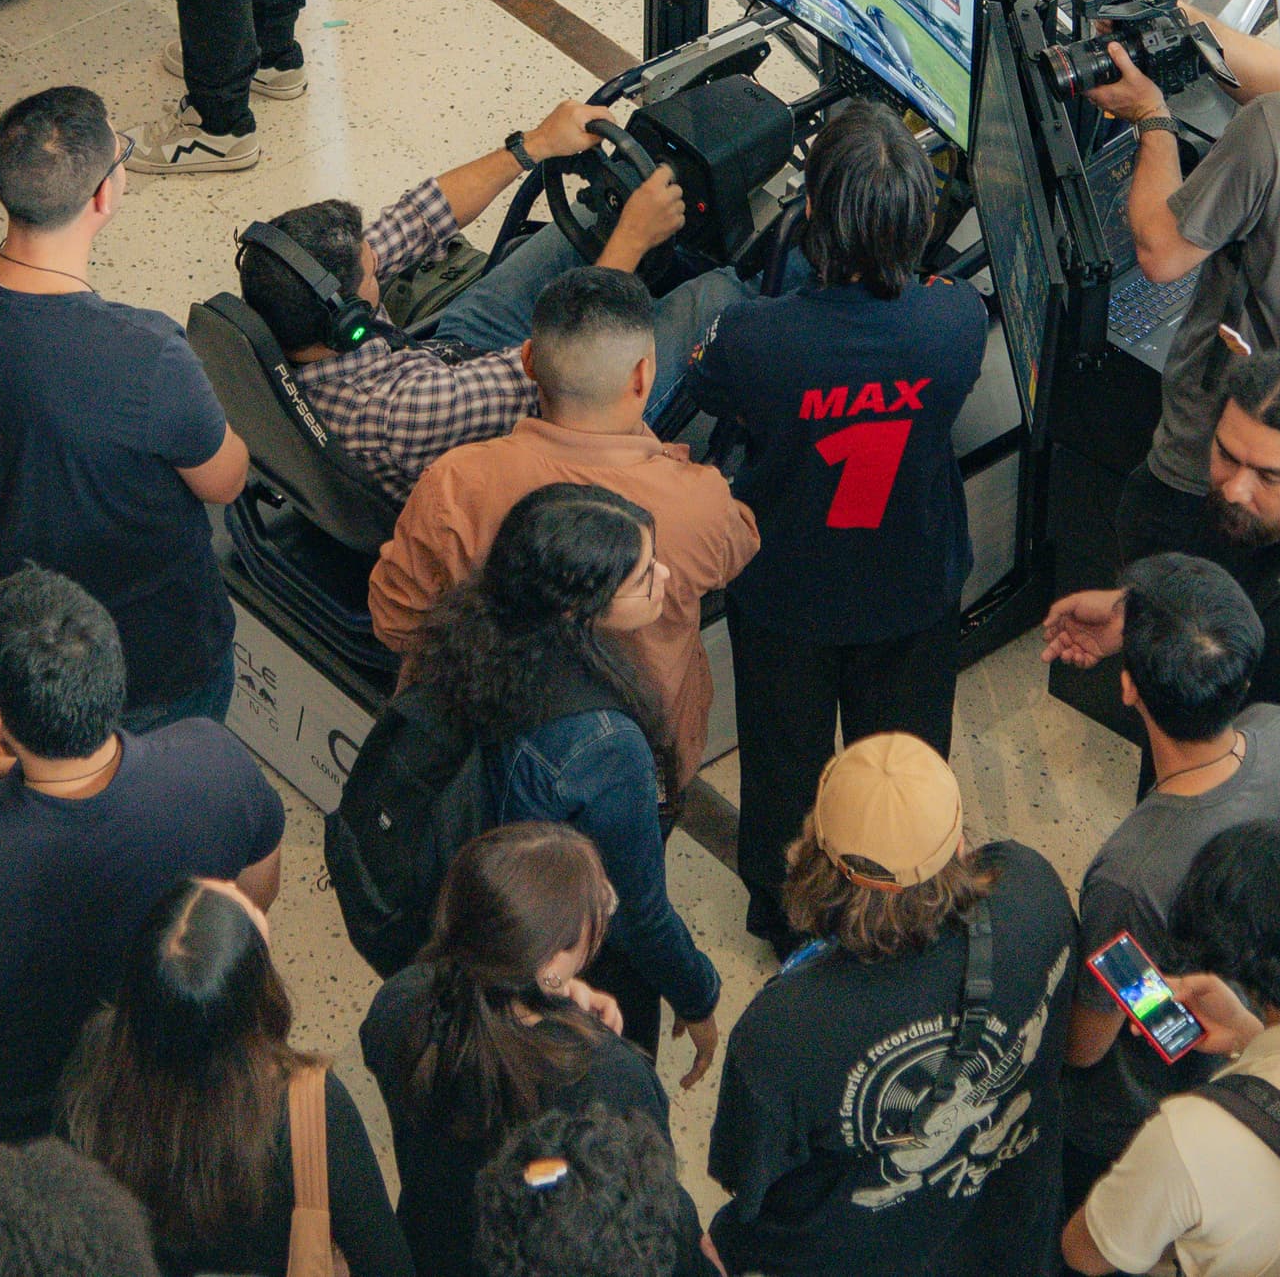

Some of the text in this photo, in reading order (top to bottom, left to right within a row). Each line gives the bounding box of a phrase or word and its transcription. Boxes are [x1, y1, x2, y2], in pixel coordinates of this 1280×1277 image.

[799, 377, 932, 420] MAX
[815, 419, 913, 529] 1
[310, 753, 342, 785] CLOUD
[840, 1014, 943, 1118] favorite recording
